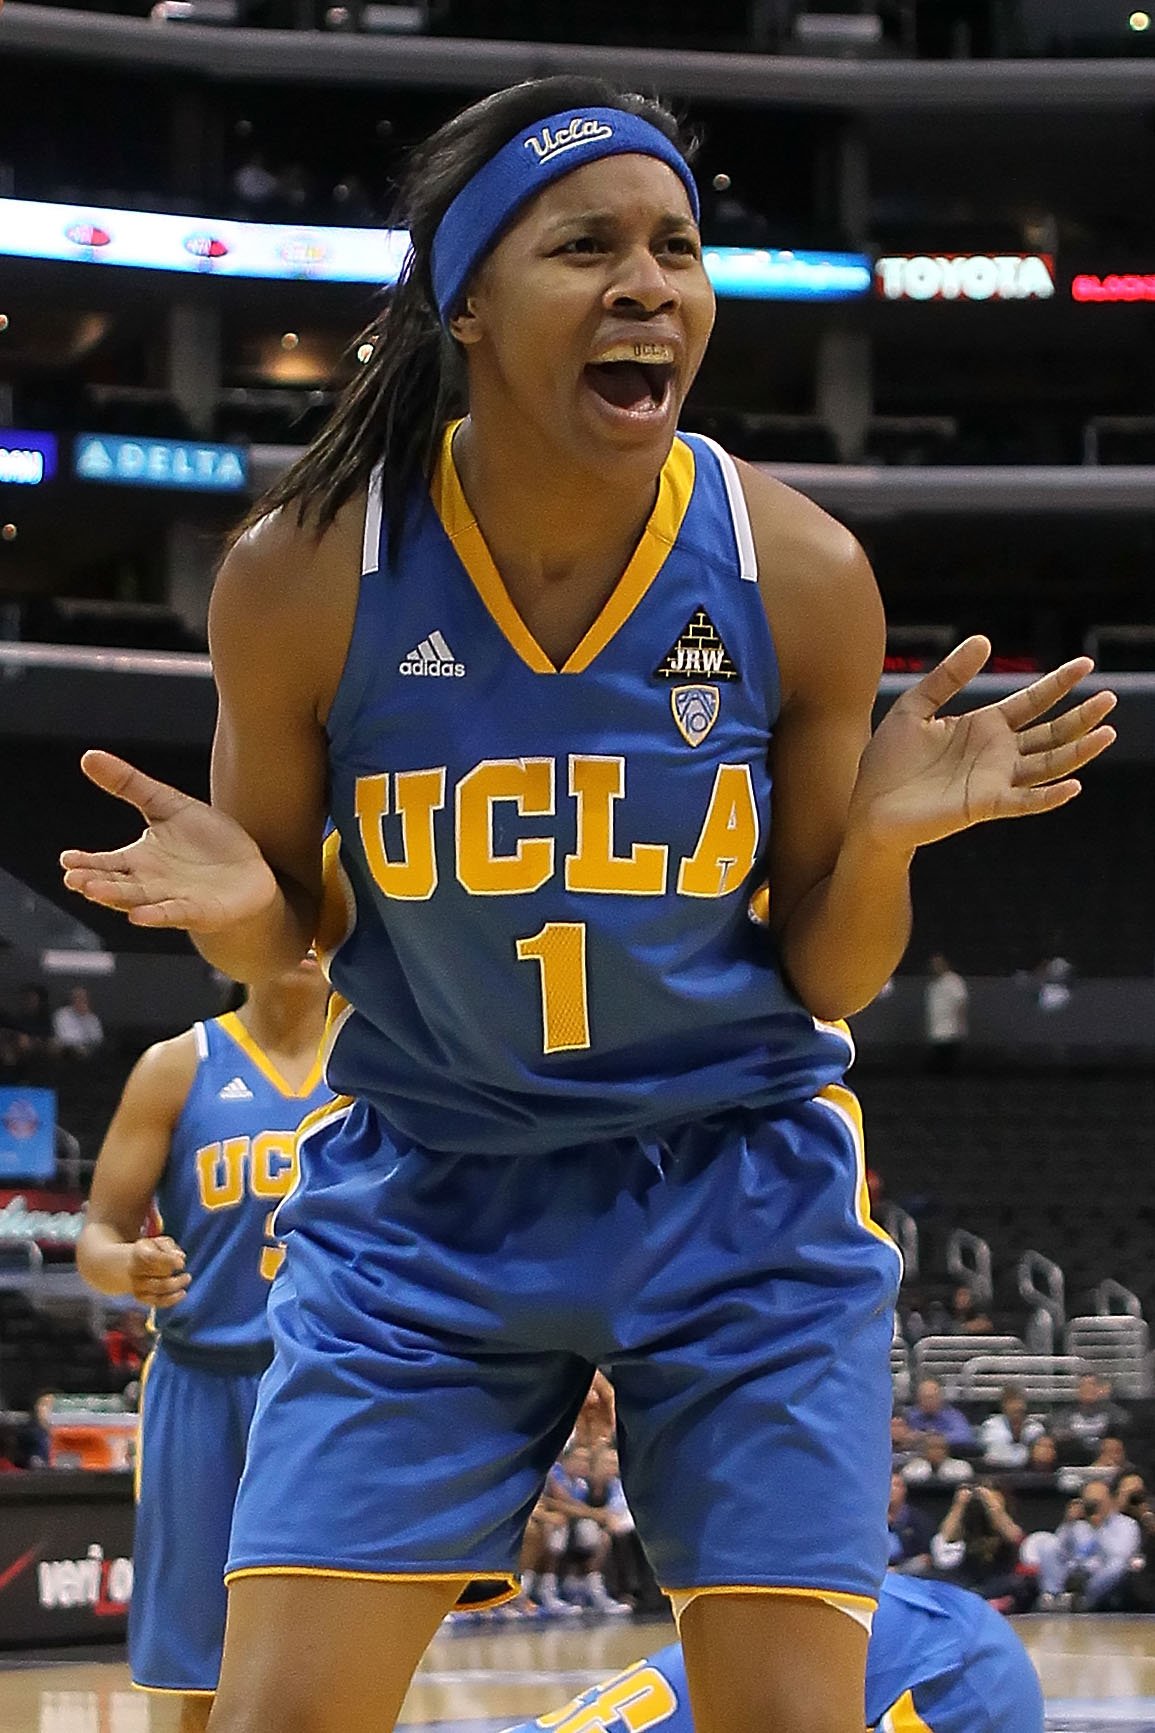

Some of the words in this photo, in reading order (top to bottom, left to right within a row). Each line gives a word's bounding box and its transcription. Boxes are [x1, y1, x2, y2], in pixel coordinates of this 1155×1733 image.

[523, 118, 614, 165] Ucla
[875, 255, 1055, 300] TOYOTA
[116, 442, 244, 483] DELTA
[399, 659, 466, 677] adidas
[670, 648, 725, 672] JRW
[354, 753, 760, 901] UCLA
[516, 922, 591, 1055] 1
[38, 1543, 134, 1616] verizo
